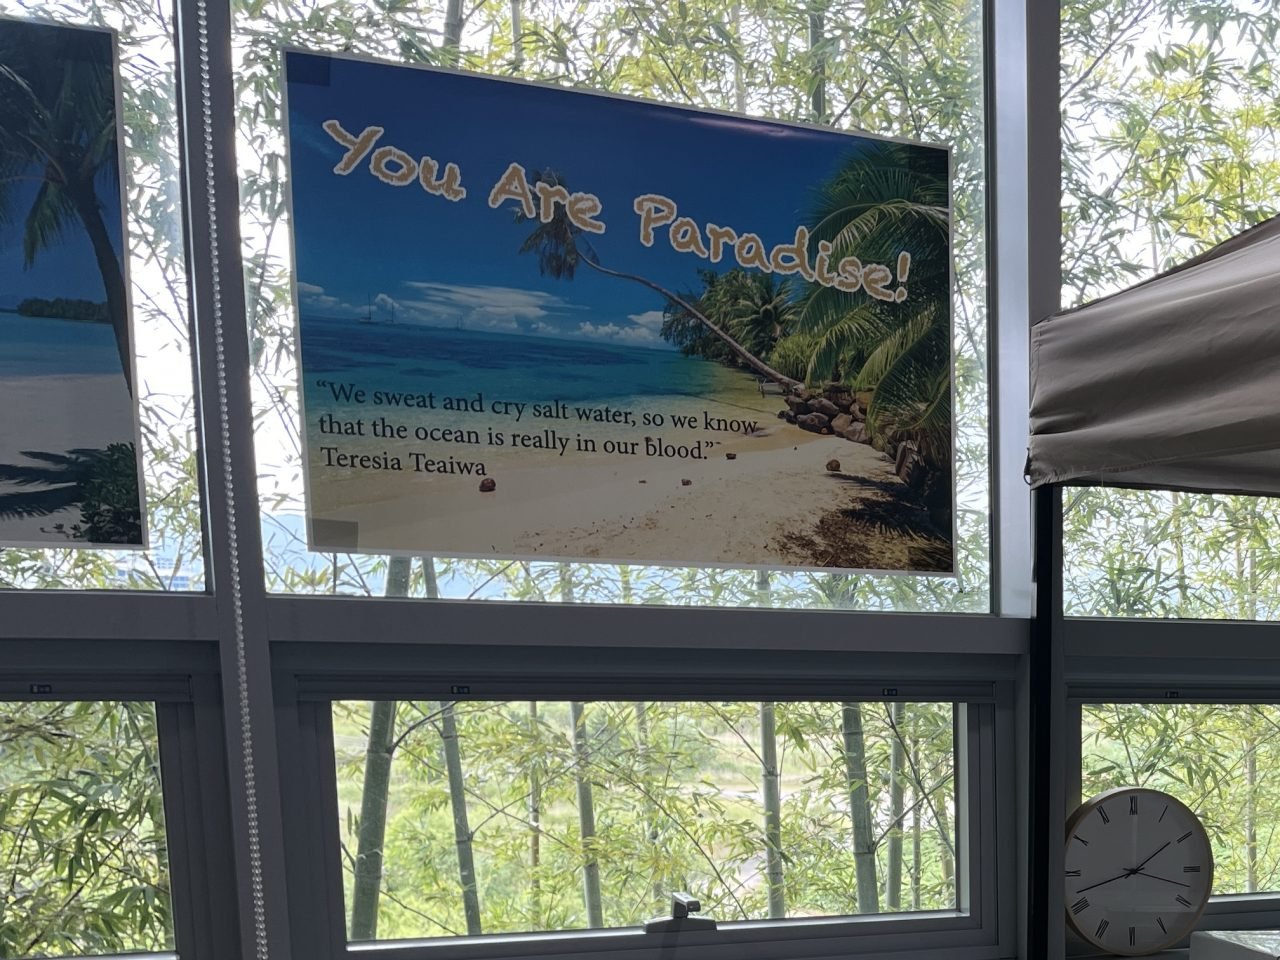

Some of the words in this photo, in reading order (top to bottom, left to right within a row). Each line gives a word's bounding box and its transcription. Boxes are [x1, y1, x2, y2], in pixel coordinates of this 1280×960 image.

[322, 119, 465, 200] You
[489, 163, 604, 234] Are
[635, 195, 911, 303] Paradise!
[318, 413, 365, 437] that
[371, 416, 407, 440] the
[415, 424, 479, 445] ocean
[487, 424, 505, 446] is
[511, 425, 569, 456] really
[576, 434, 596, 453] in
[603, 439, 638, 455] our
[374, 390, 436, 411] sweat
[443, 390, 483, 413] and
[492, 400, 525, 423] cry
[533, 397, 569, 421] salt
[575, 404, 636, 428] water,
[642, 411, 664, 428] so
[669, 415, 698, 430] we
[703, 412, 758, 435] know
[320, 447, 401, 472] Teresia
[408, 451, 486, 477] Teaiwa
